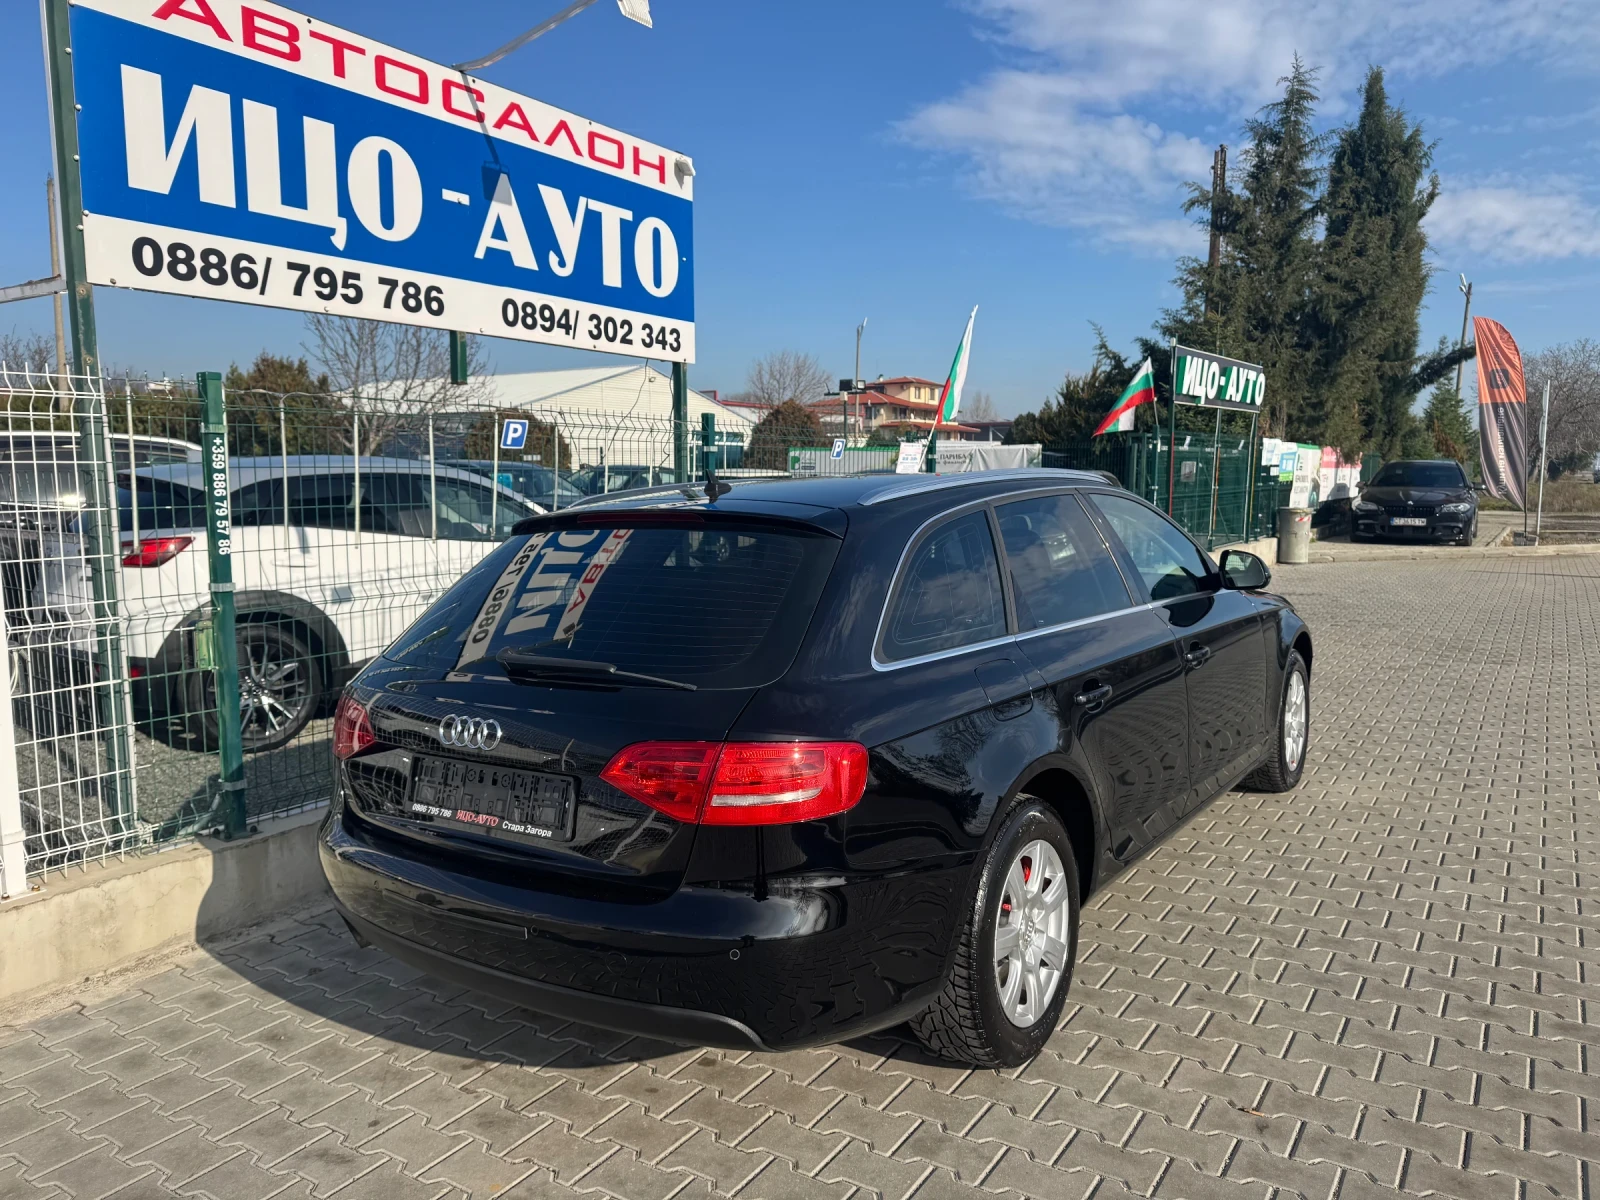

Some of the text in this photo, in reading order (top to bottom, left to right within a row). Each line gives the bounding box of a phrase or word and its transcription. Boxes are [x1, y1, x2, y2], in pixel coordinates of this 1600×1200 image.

[151, 0, 666, 185] АВТОСАЛОН
[131, 236, 682, 353] 0886/ 795 786 0894/ 302 343
[1181, 355, 1266, 406] ИЦО-АУТО
[211, 436, 231, 556] +359 886 79 57 86
[427, 804, 440, 816] 795
[440, 807, 453, 818] 786
[455, 809, 499, 827] ИЦО-АУТО
[502, 820, 525, 833] Стара
[525, 823, 552, 838] Загора
